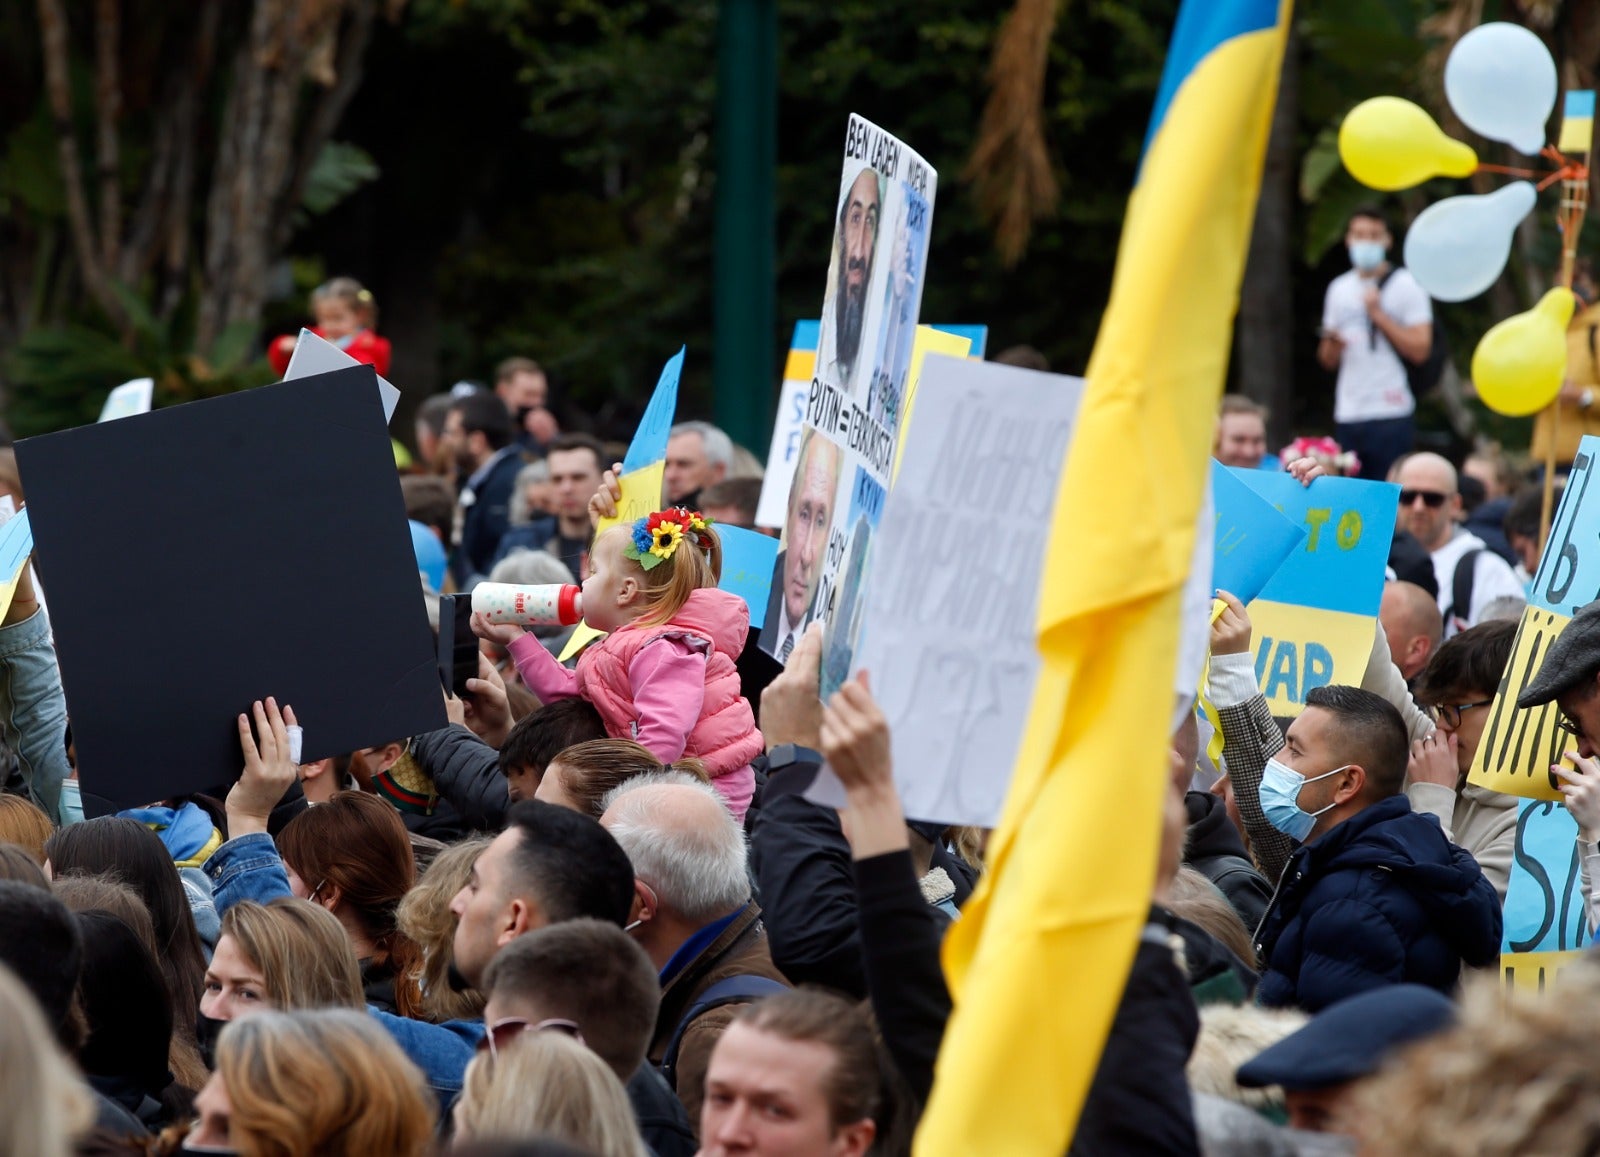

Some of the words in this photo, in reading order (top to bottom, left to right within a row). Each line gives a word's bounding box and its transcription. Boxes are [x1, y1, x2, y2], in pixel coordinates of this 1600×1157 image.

[847, 118, 871, 160] BEN
[871, 132, 902, 180] LADEN
[806, 377, 843, 434] PUTIN
[847, 402, 894, 479] TERRORISTA
[857, 469, 883, 516] KYIV
[827, 526, 848, 573] HOY
[1304, 508, 1363, 552] TO
